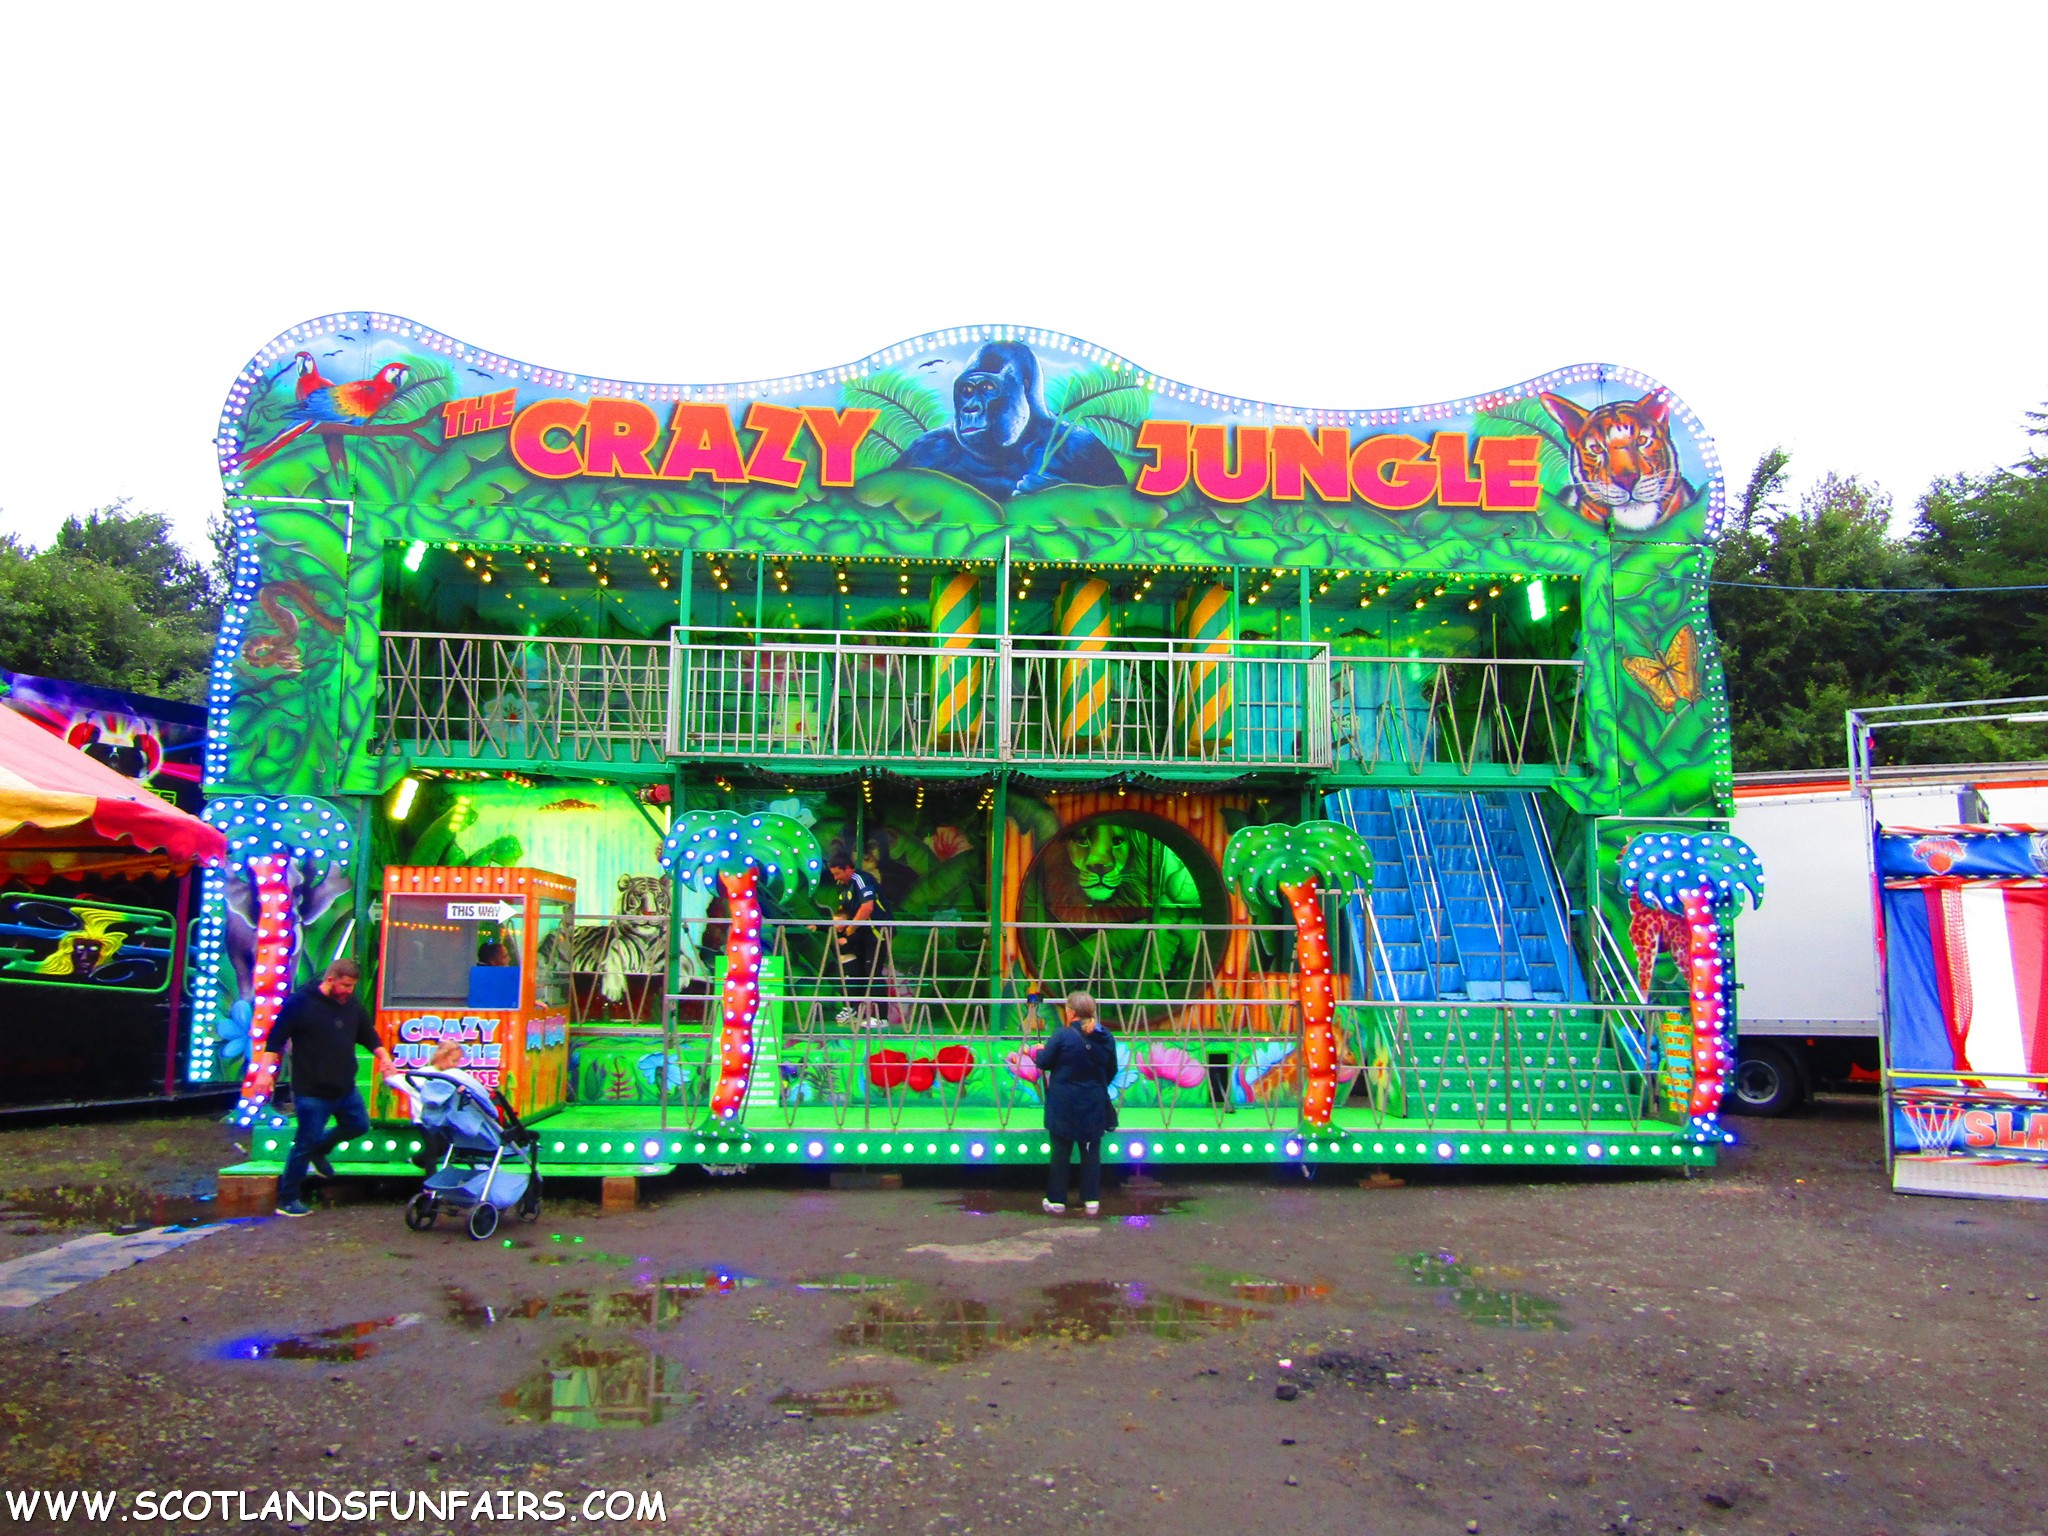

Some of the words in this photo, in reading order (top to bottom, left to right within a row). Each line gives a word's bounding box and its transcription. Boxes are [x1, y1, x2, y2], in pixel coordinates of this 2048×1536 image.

[441, 387, 518, 439] THE
[509, 397, 881, 489] CRAZY
[1135, 420, 1542, 512] JUNGLE
[451, 905, 475, 917] THIS
[478, 905, 501, 917] WAY
[401, 1015, 501, 1042] CRAZY
